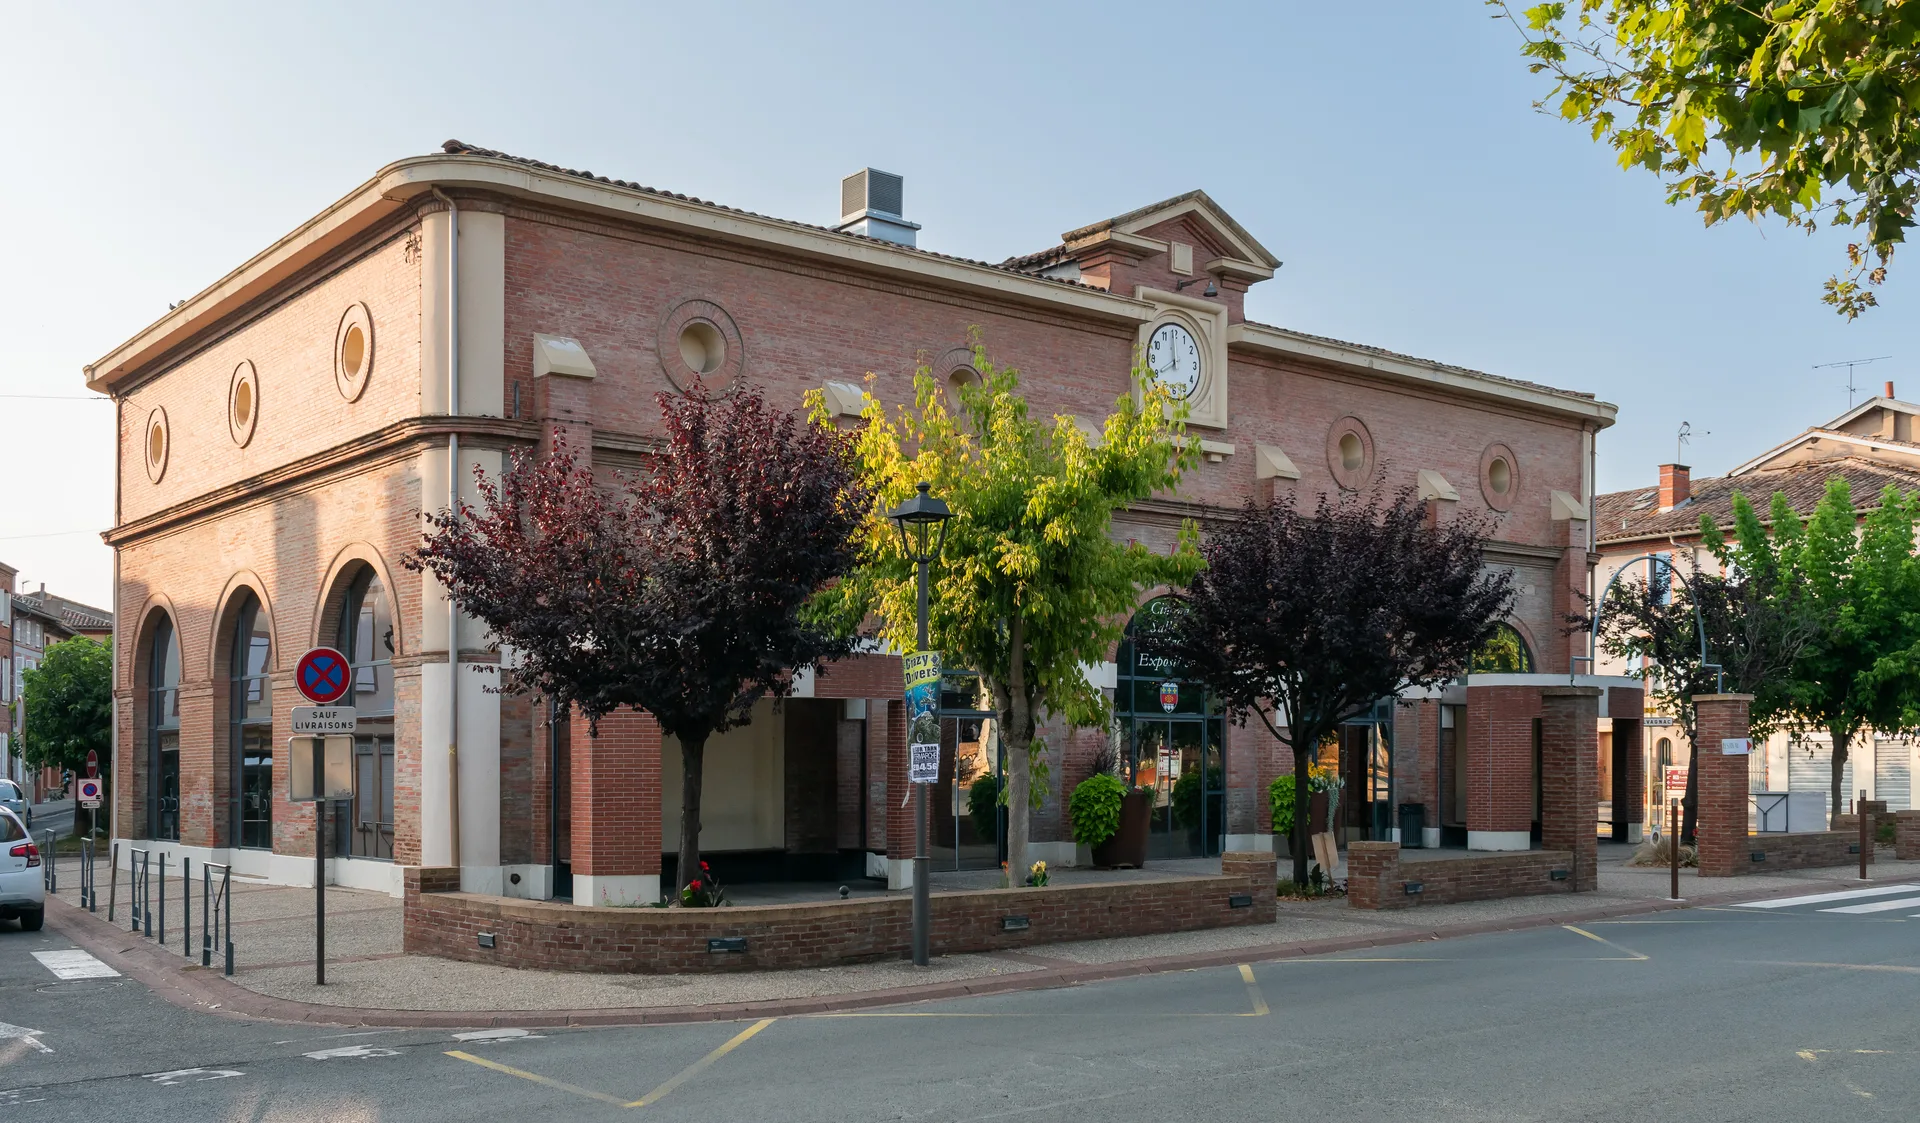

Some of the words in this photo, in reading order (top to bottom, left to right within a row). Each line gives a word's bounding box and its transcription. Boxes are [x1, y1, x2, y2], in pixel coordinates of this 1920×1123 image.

[1162, 331, 1167, 341] 11
[1154, 341, 1160, 350] 10
[1189, 346, 1193, 354] 2
[1151, 354, 1155, 363] 9
[1193, 362, 1197, 370] 3
[1189, 375, 1193, 384] 4
[905, 655, 928, 670] Crazy
[905, 667, 937, 684] Drivers
[312, 711, 337, 719] SAUF
[295, 721, 353, 729] LIVRAISONS
